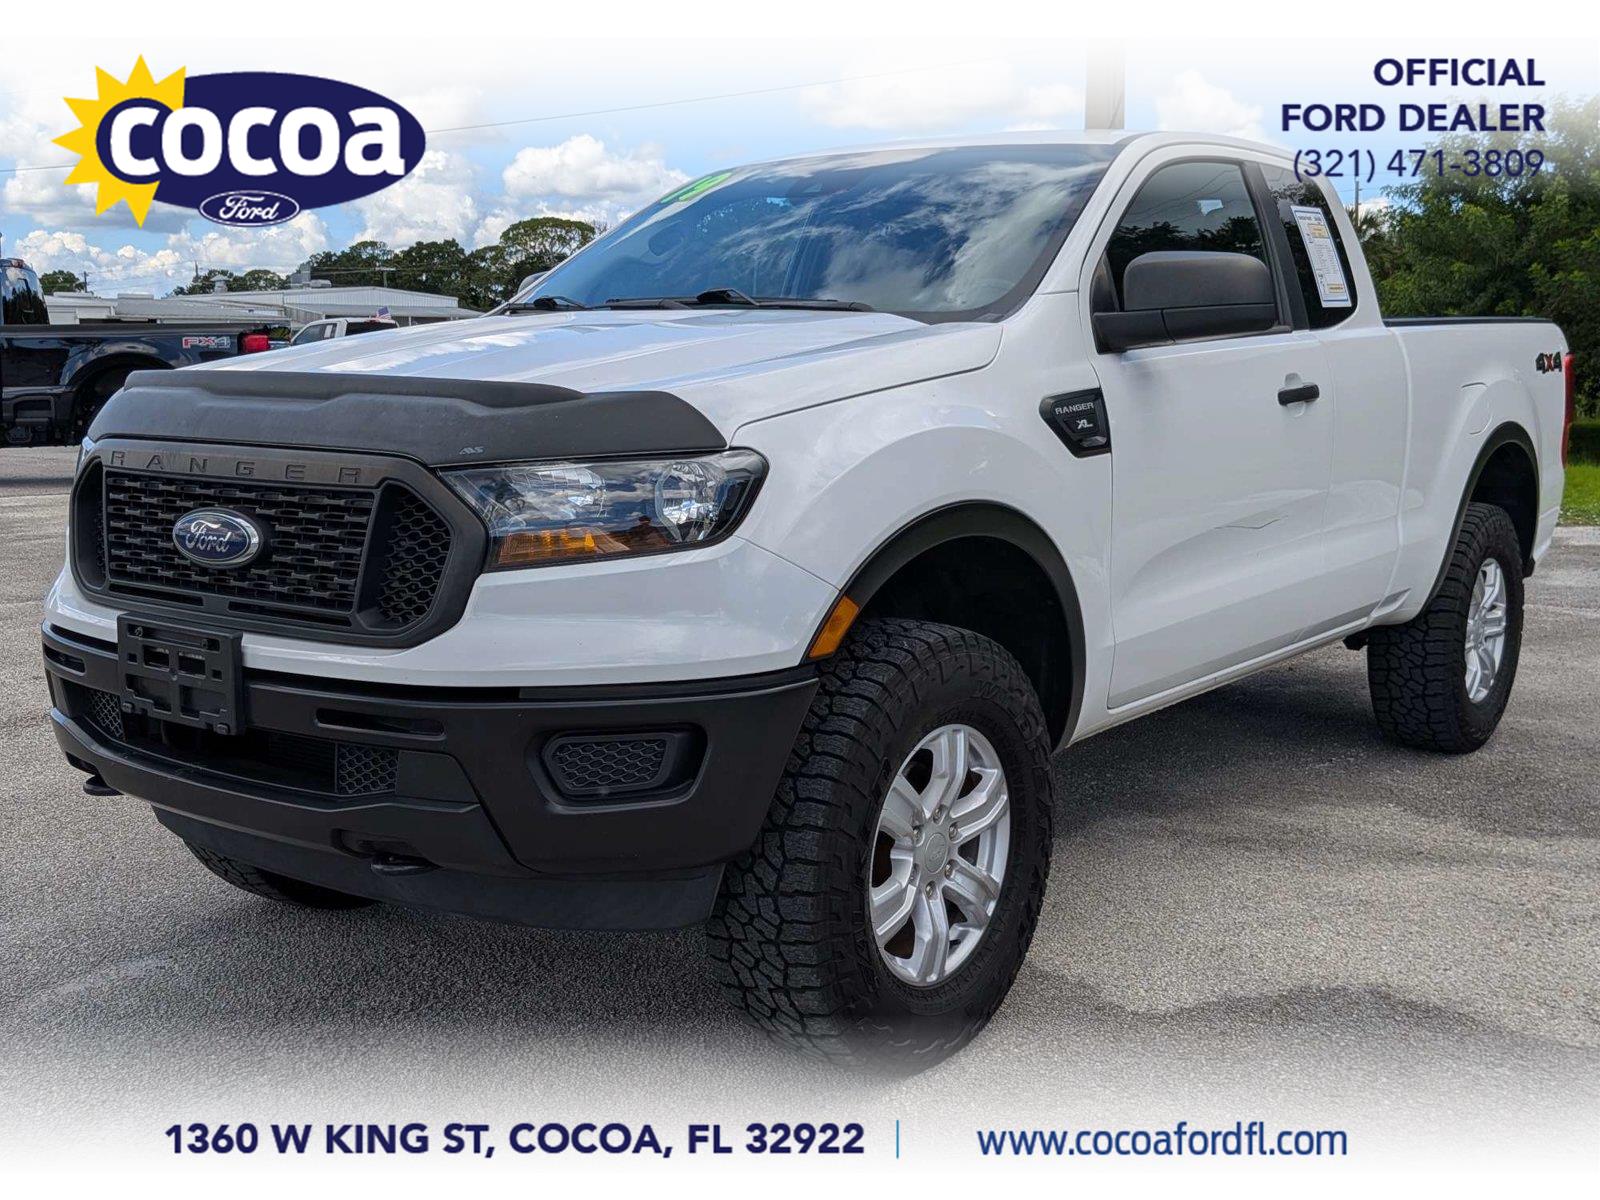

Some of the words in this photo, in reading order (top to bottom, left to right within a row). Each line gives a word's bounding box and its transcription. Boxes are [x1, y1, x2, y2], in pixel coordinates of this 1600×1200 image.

[182, 336, 231, 349] FX4
[1055, 402, 1095, 415] RANGER
[1076, 419, 1093, 430] XL
[110, 450, 361, 484] RANGER
[186, 518, 233, 554] Ford
